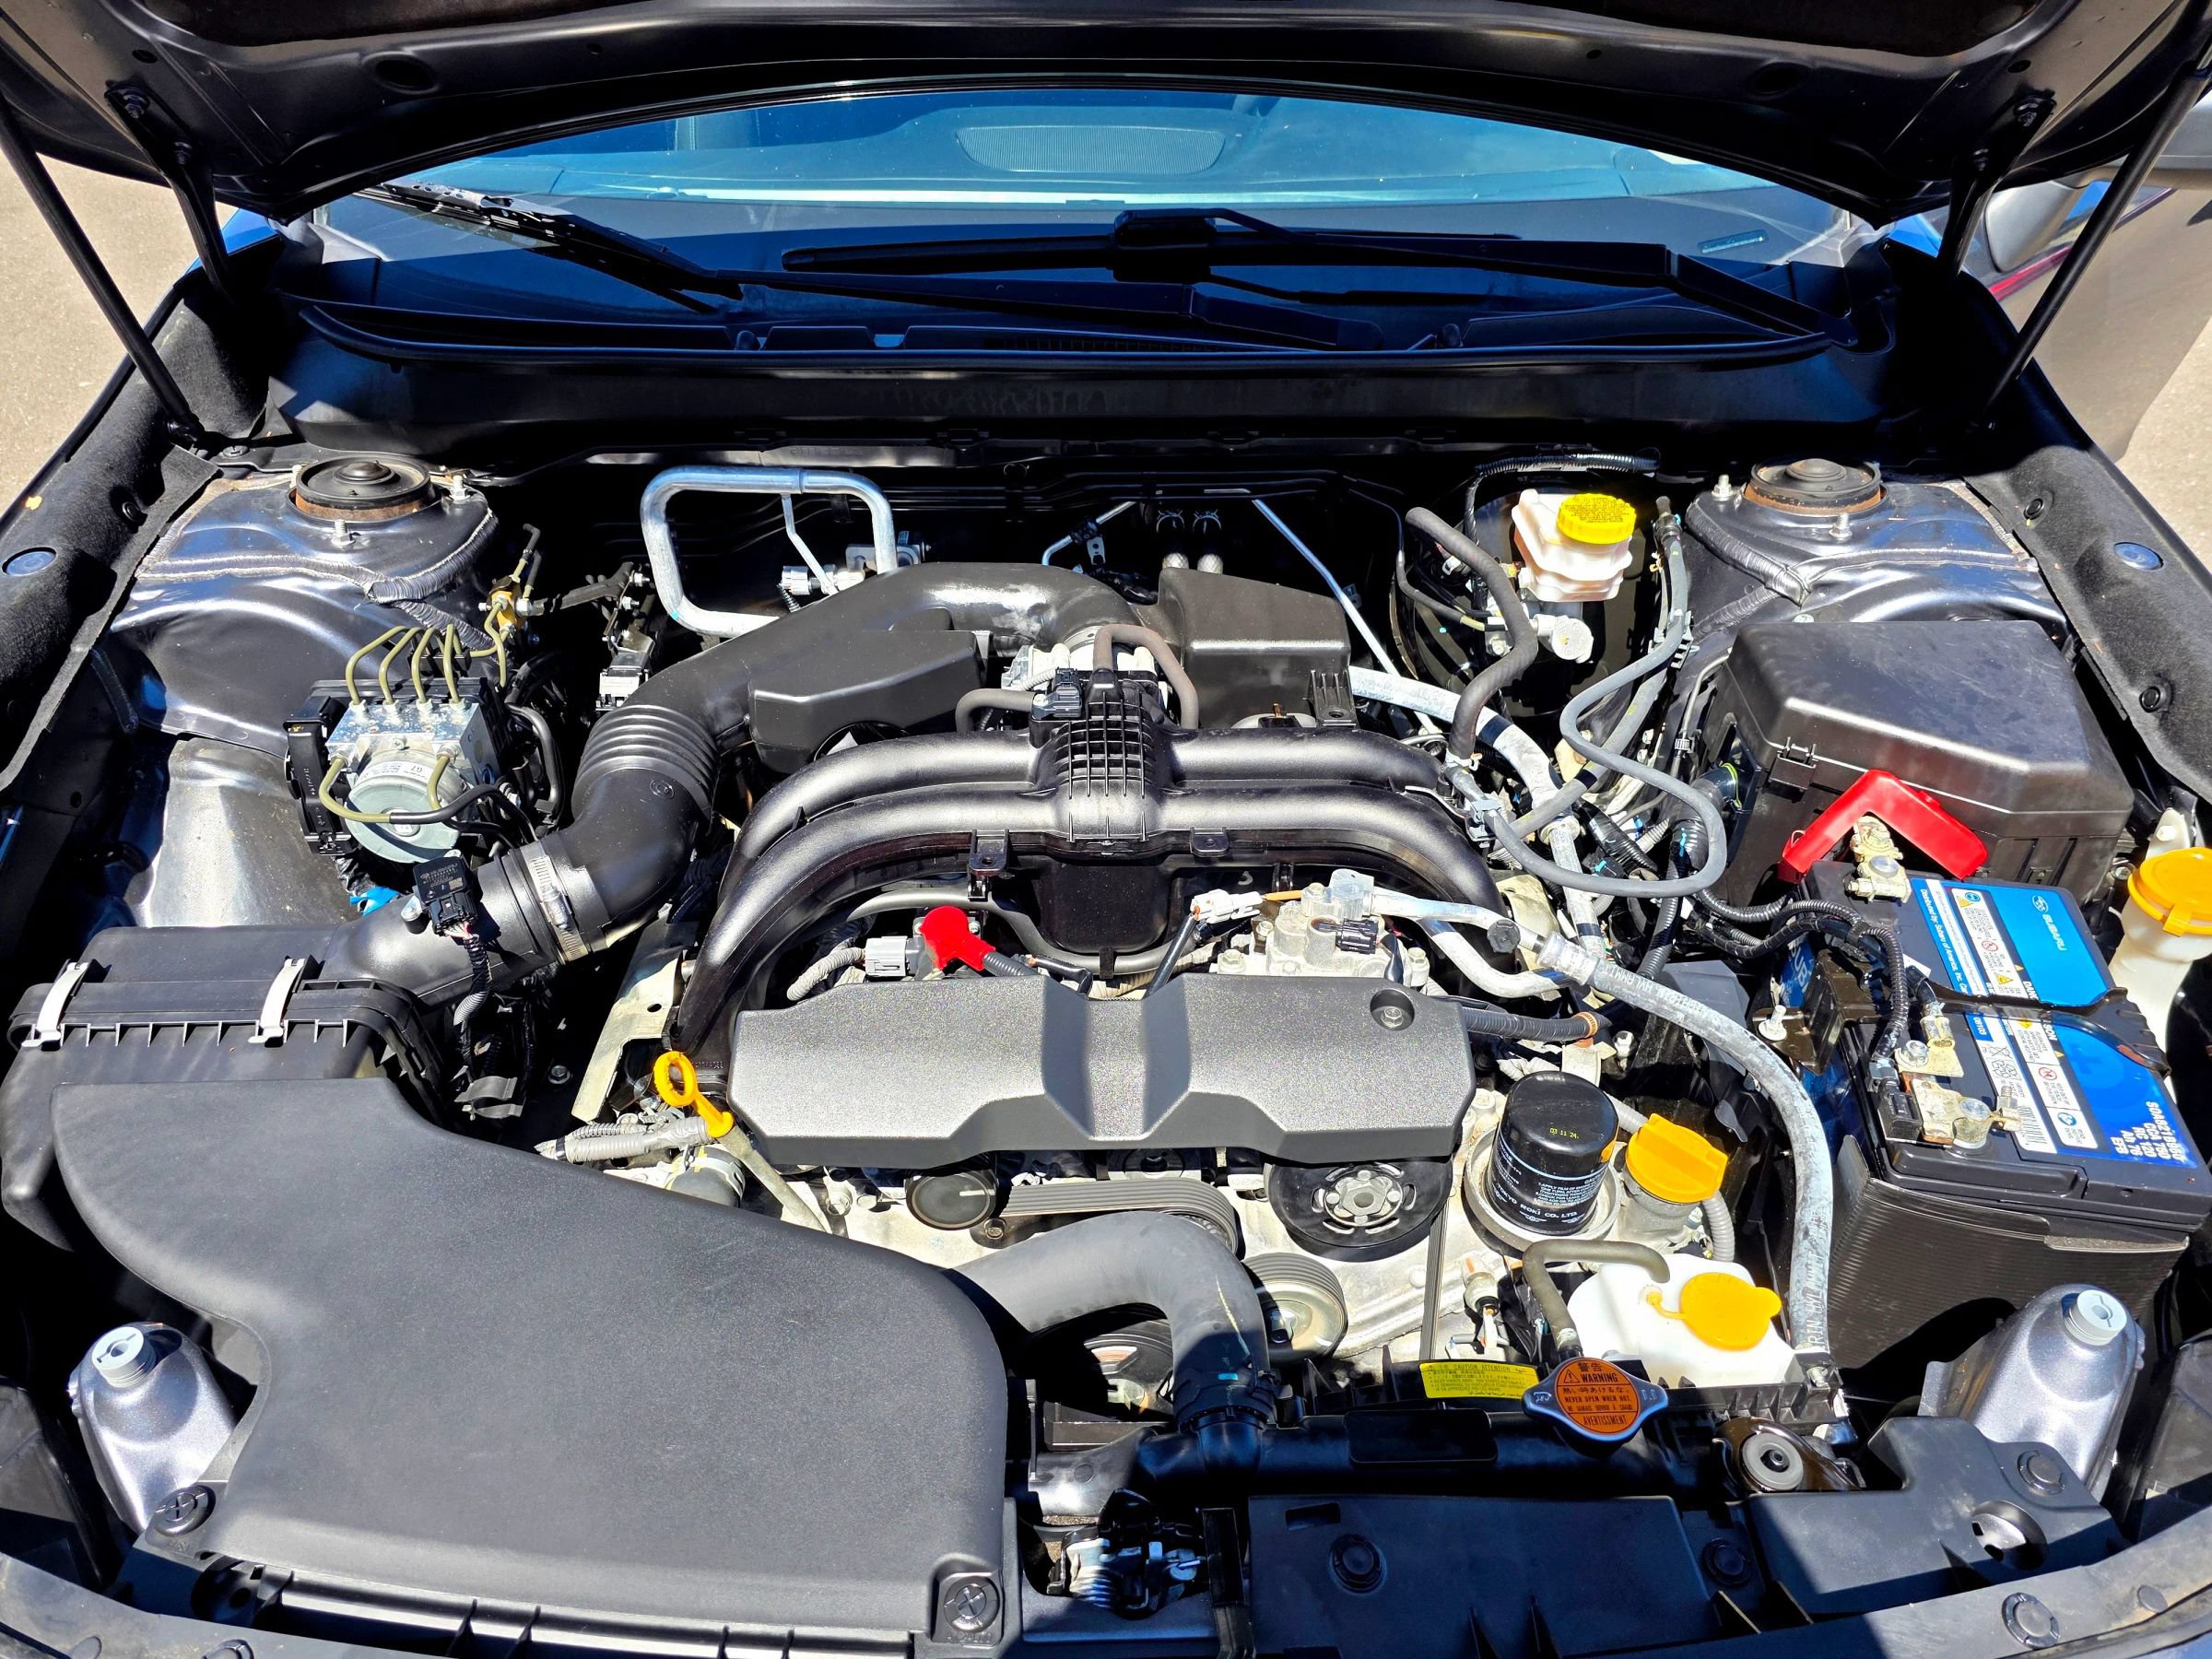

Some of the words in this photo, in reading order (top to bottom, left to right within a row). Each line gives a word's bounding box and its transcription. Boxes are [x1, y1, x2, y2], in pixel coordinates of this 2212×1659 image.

[2042, 914, 2067, 951] SUBARU
[2120, 1130, 2136, 1143] Ah
[2132, 1127, 2149, 1140] RC
[2143, 1123, 2162, 1140] CCA
[2140, 1141, 2157, 1157] 120
[1497, 1183, 1517, 1205] TOKYO
[1578, 1362, 1602, 1372] 警告
[1581, 1373, 1618, 1383] WARNING
